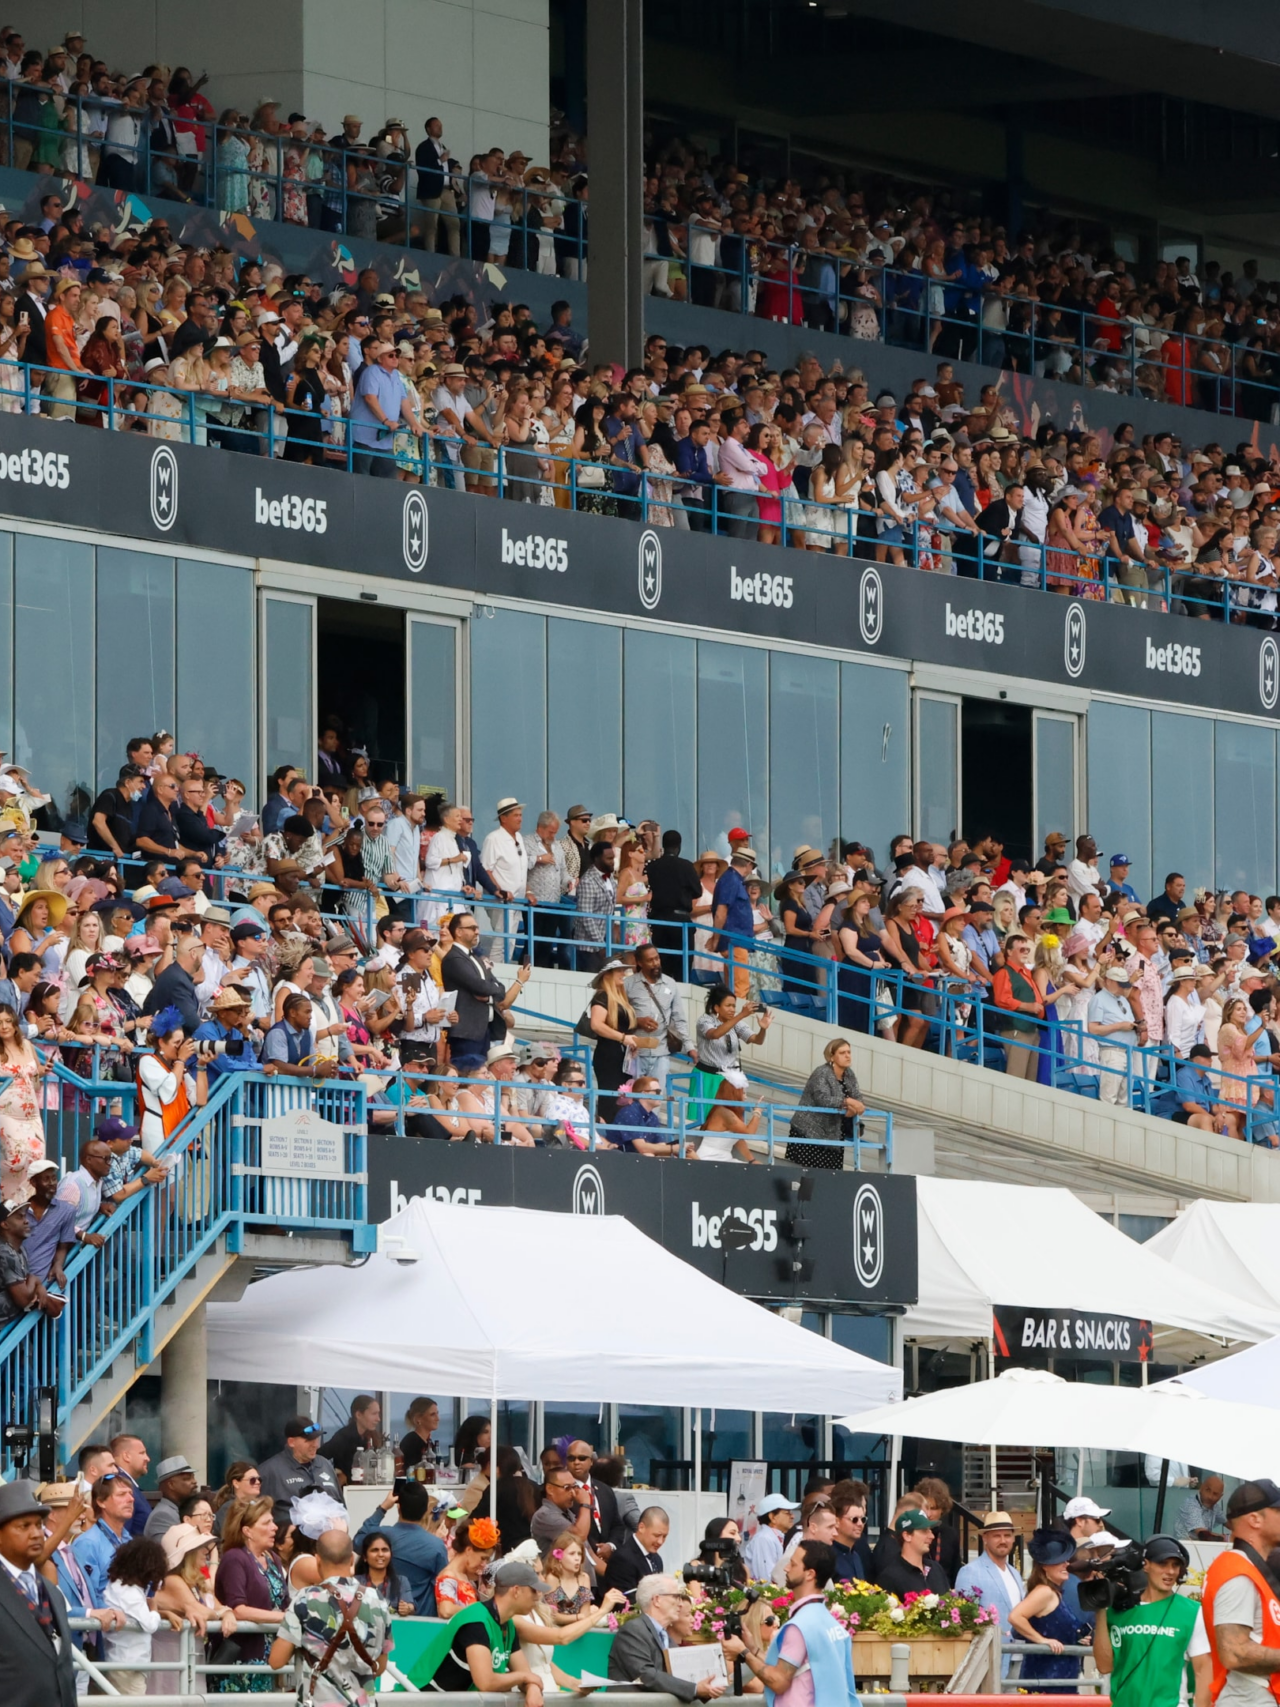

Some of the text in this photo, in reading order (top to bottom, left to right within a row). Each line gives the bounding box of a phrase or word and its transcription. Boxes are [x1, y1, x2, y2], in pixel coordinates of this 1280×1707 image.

[158, 466, 170, 486] W
[255, 487, 327, 533] bet365
[410, 510, 421, 528] W
[502, 528, 568, 572] bet365
[645, 547, 656, 567] W
[731, 566, 793, 608] bet365
[866, 586, 877, 604] W
[946, 603, 1004, 644] bet365
[1071, 619, 1081, 637] W
[1146, 637, 1201, 677] bet365
[1264, 652, 1275, 671] W
[862, 1210, 875, 1233] W
[1022, 1318, 1131, 1350] BAR & SNACKS
